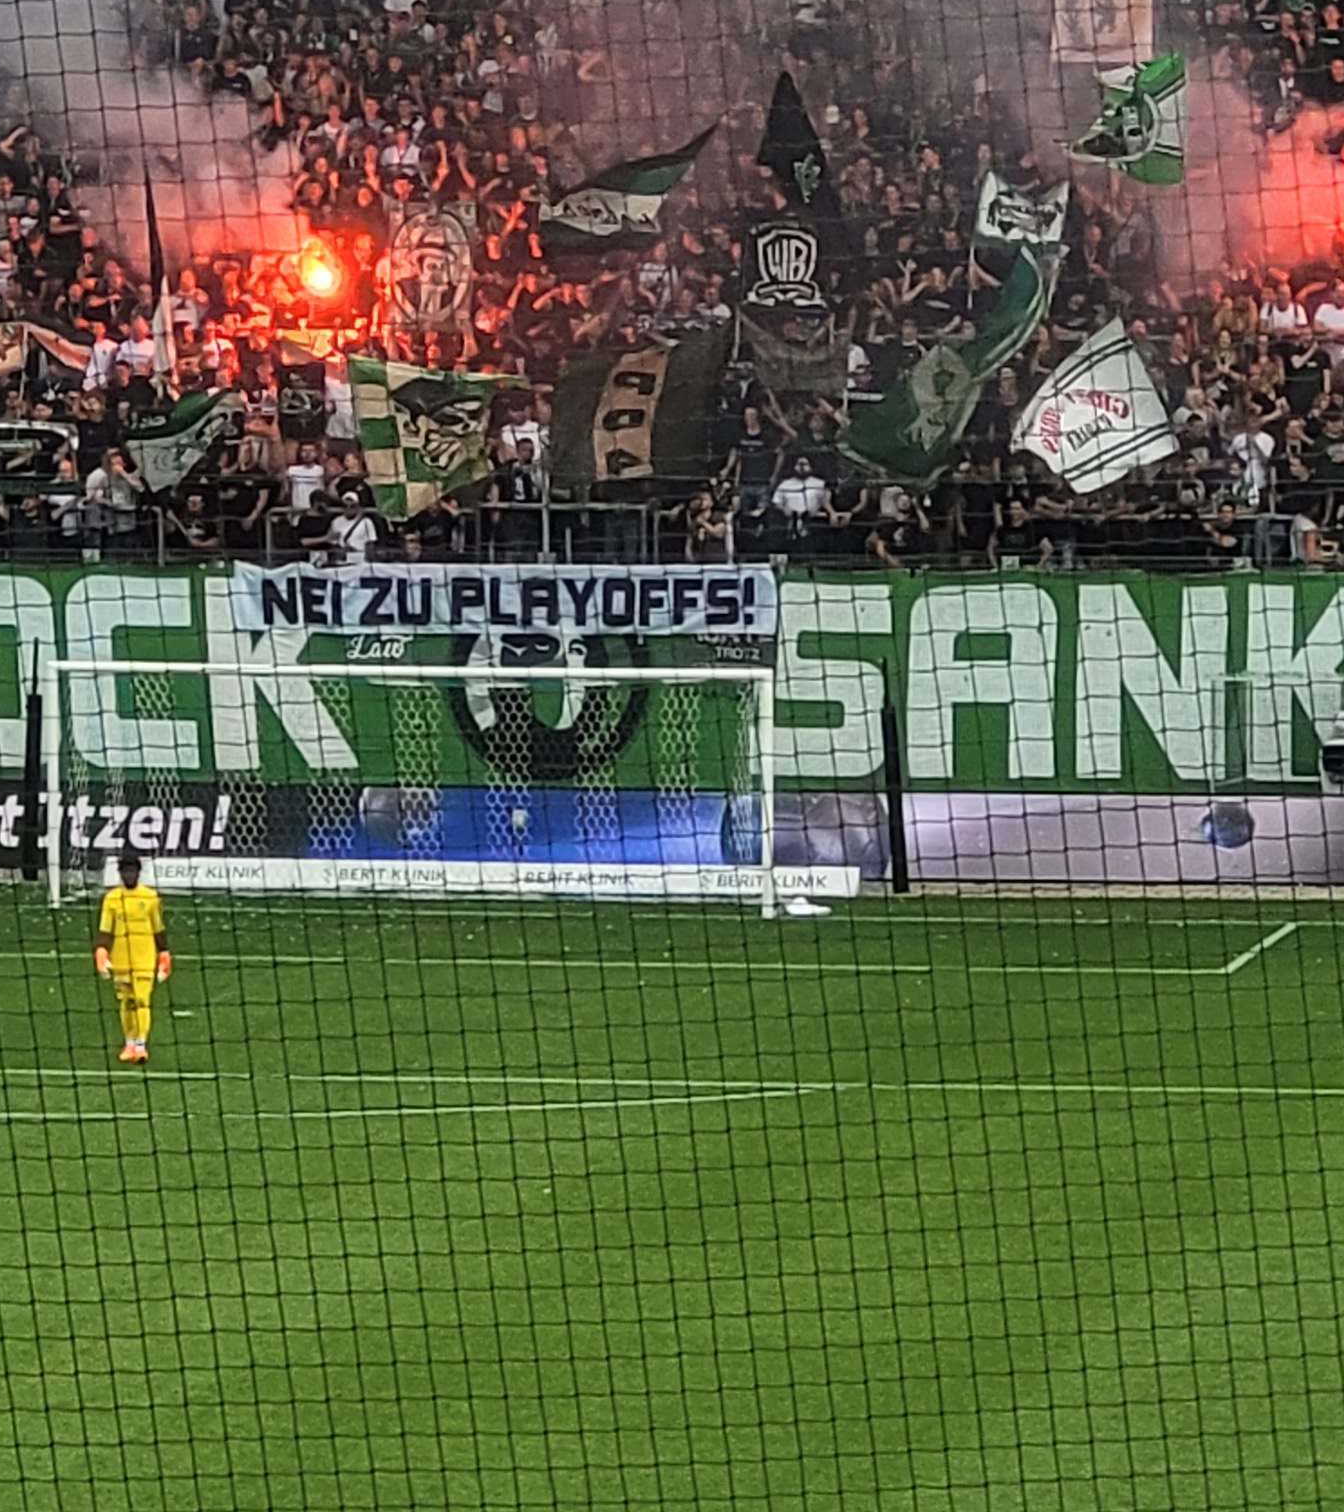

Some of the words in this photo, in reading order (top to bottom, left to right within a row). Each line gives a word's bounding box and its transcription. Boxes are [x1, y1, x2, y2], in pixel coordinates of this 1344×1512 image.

[262, 577, 343, 626] NEI
[358, 576, 432, 625] ZU
[451, 575, 755, 628] PLAYOFFS!
[206, 864, 265, 880] KLINIK
[339, 866, 388, 881] BERIT
[391, 867, 447, 883] KLINIK
[716, 874, 763, 888] BERIT
[771, 874, 829, 889] KLINIK
